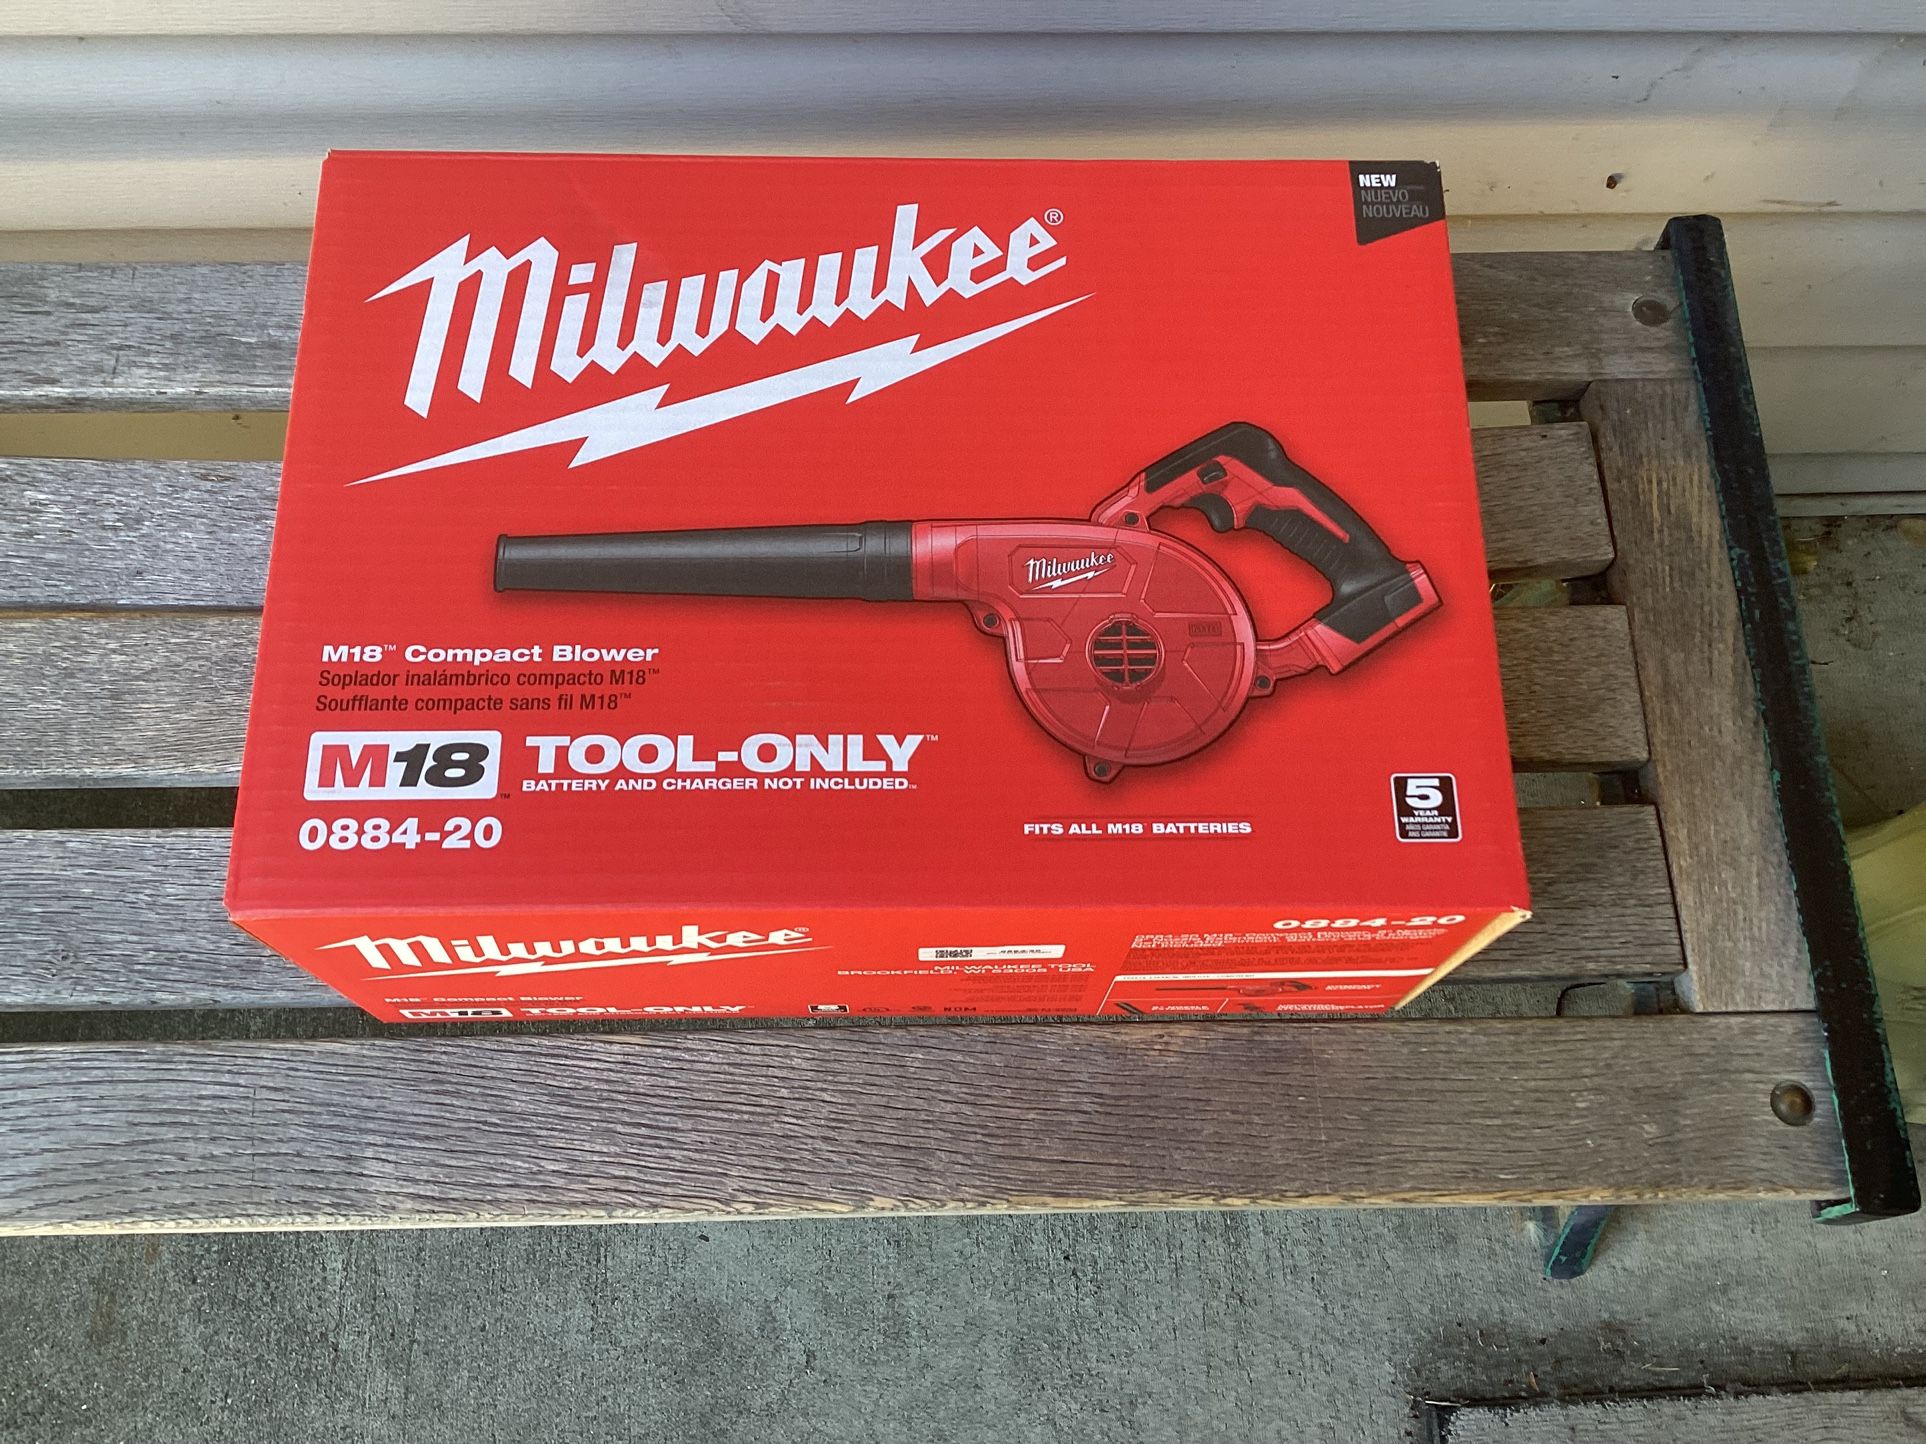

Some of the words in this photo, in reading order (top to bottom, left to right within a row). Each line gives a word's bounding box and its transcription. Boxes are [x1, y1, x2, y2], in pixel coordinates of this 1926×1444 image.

[1358, 174, 1397, 187] NEW
[1361, 190, 1409, 202] NUEVO
[1362, 204, 1429, 218] NOUVEAU
[1023, 551, 1114, 584] Milwaukee
[404, 645, 543, 666] Compact
[552, 645, 659, 662] Blower
[318, 670, 400, 689] Soplador
[405, 669, 511, 686] inalámbrico
[517, 670, 604, 688] compacto
[315, 695, 408, 712] Soufflante
[415, 697, 503, 714] compacte
[509, 698, 551, 710] sans
[557, 694, 573, 710] fil
[521, 778, 609, 791] BATTERY
[614, 778, 656, 790] AND
[662, 778, 757, 790] CHARGER
[764, 777, 804, 789] NOT
[1405, 778, 1443, 809] 5
[298, 816, 503, 851] 0884-20
[1023, 823, 1064, 834] FITS
[1068, 823, 1102, 834] ALL
[1152, 822, 1252, 834] BATTERIES
[1273, 914, 1466, 929] 0884-20
